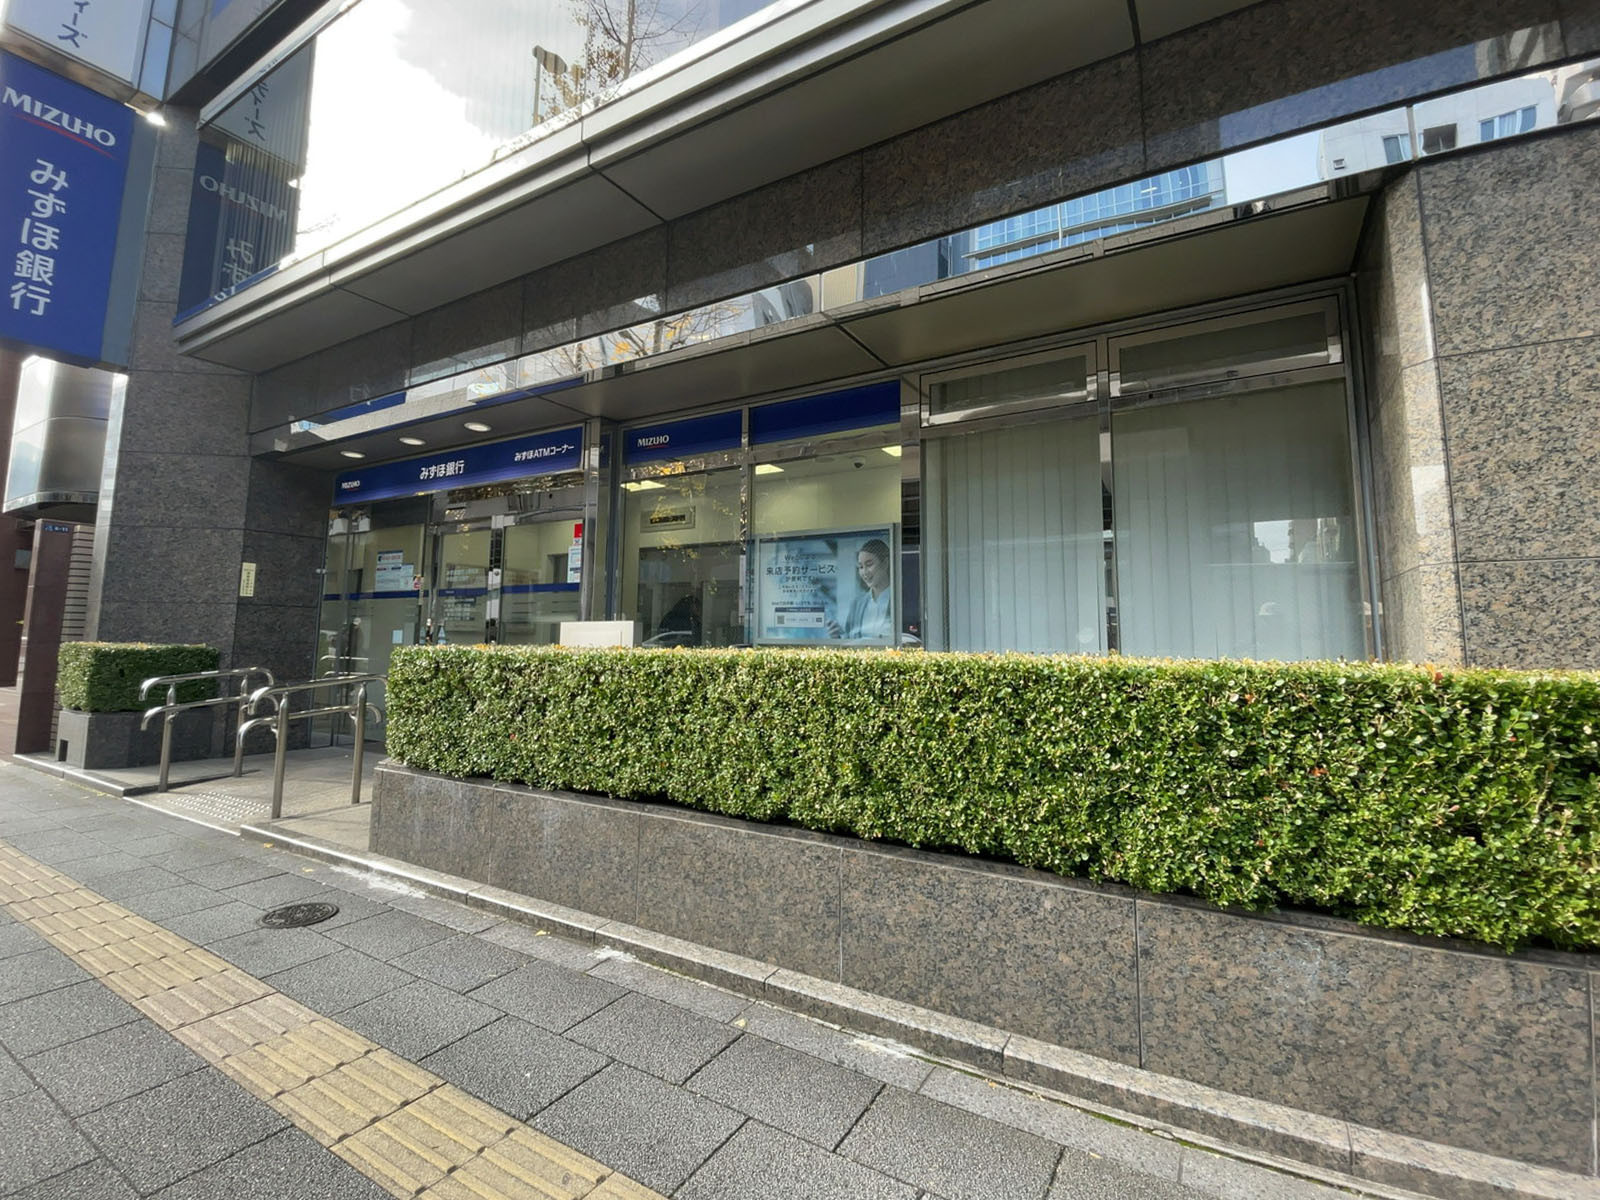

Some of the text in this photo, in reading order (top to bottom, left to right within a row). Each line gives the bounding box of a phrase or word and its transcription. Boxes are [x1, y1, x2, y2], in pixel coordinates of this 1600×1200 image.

[2, 86, 116, 148] MIZUHO
[10, 158, 69, 316] みずほ銀行
[637, 434, 670, 447] MIZUHO
[514, 444, 575, 461] みずほATMコーナー
[419, 460, 465, 480] みずほ銀行
[765, 564, 836, 576] 来店予約サービス
